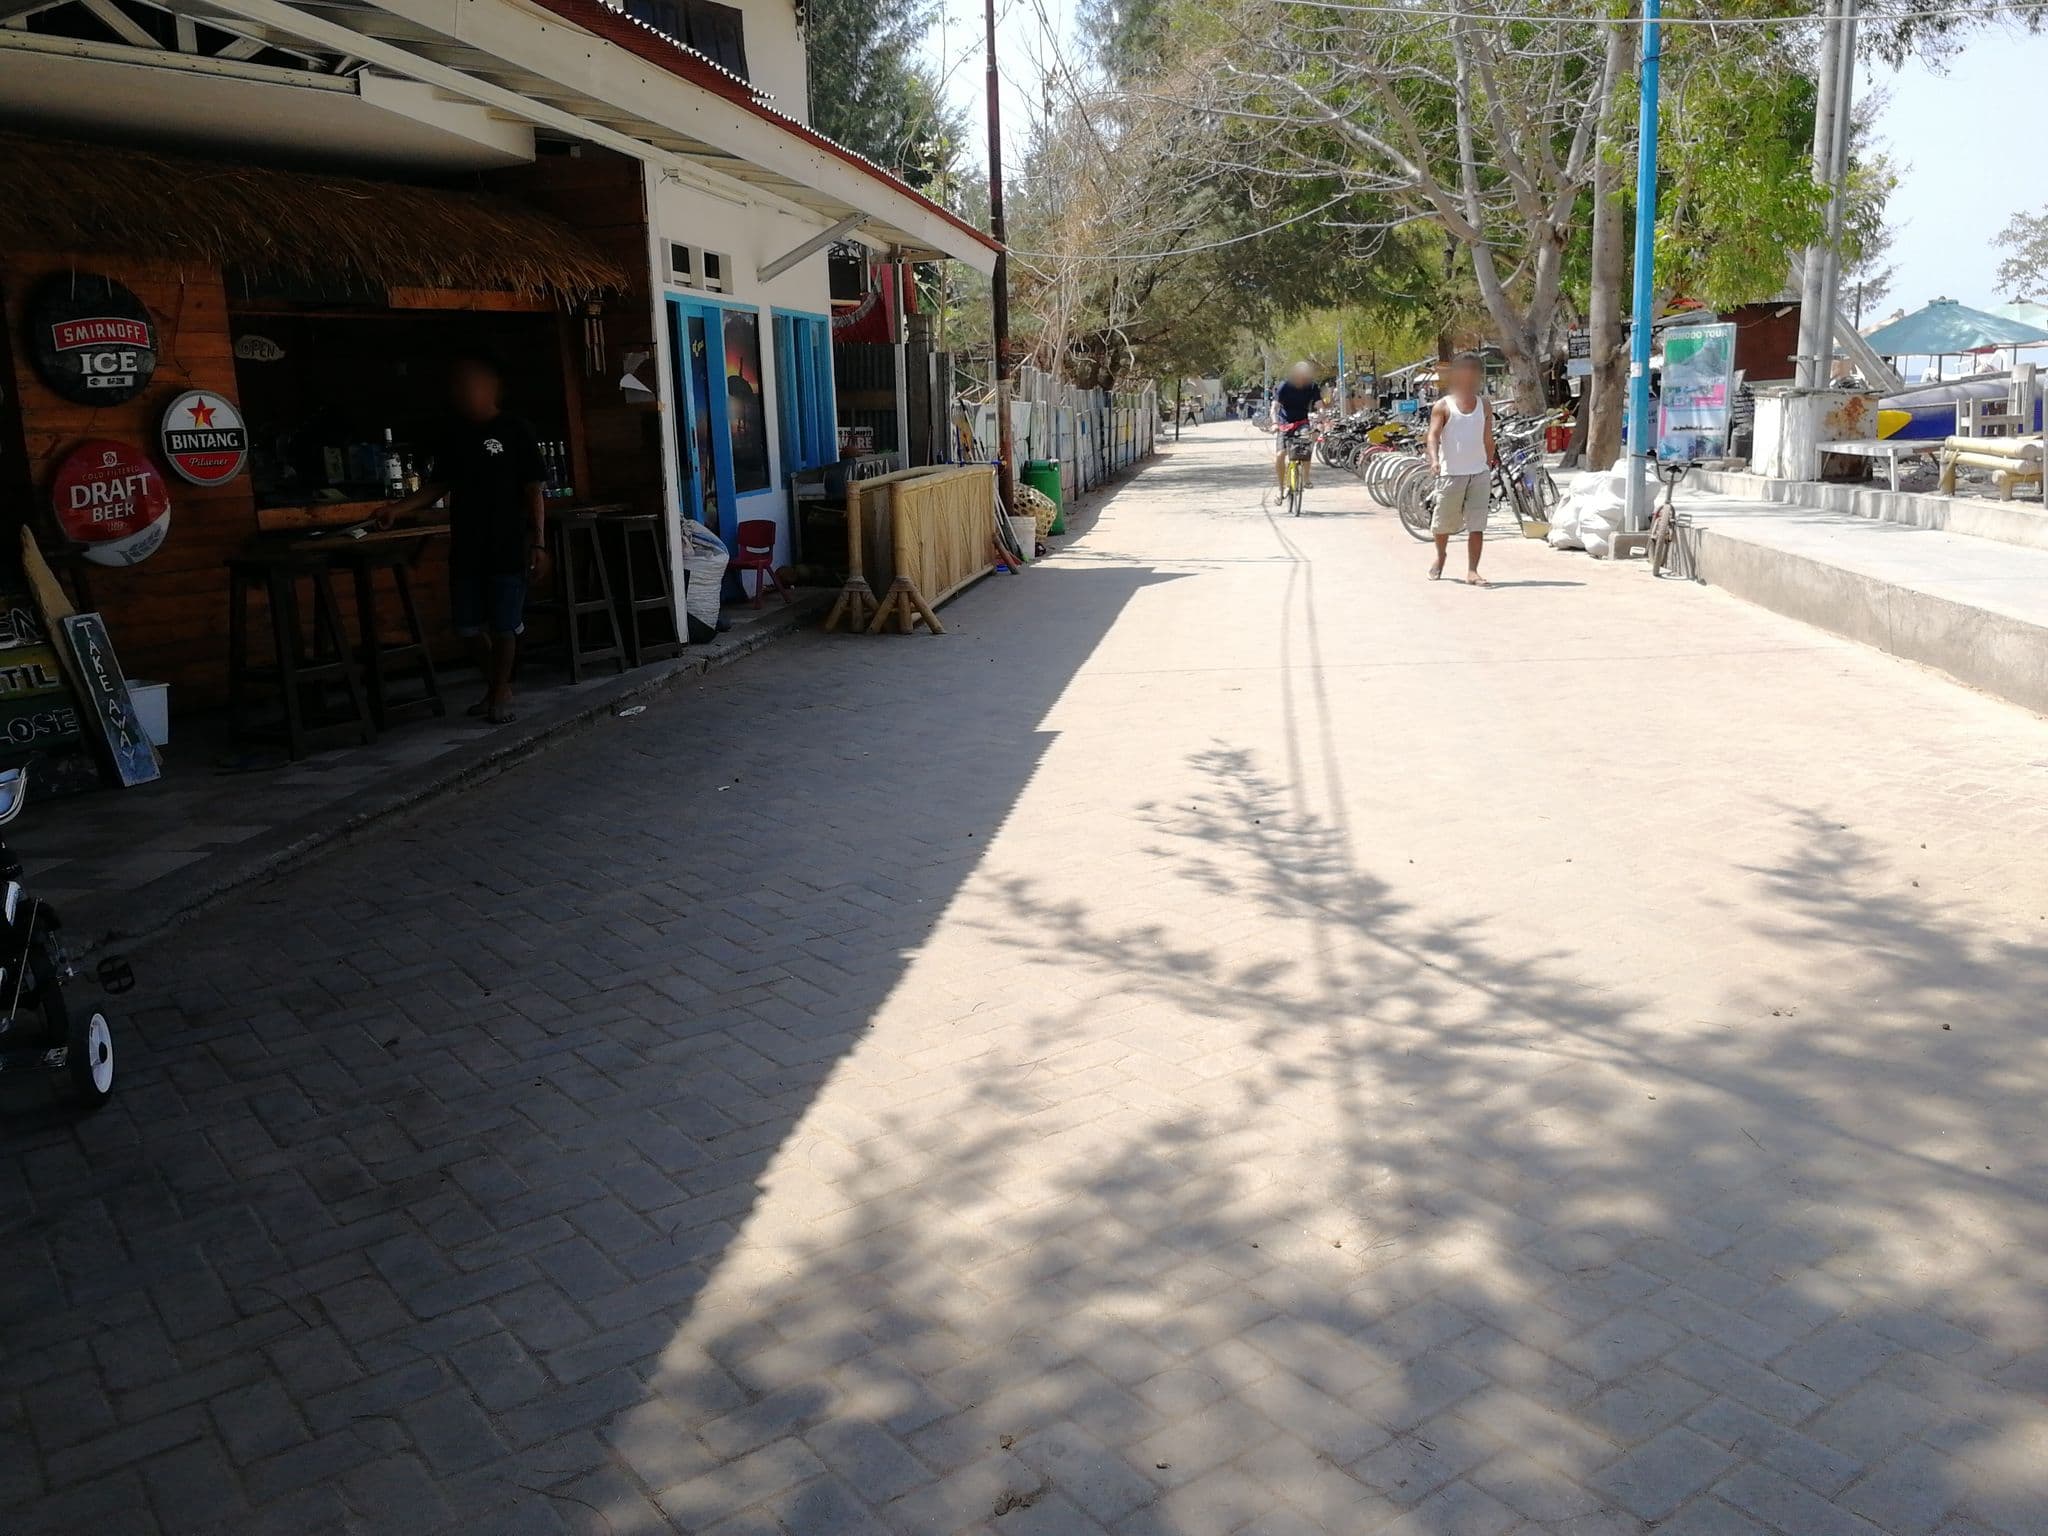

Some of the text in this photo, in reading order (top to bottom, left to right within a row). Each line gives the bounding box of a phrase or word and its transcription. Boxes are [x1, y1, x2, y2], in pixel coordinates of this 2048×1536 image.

[63, 323, 142, 343] SMIRNOFF
[80, 351, 138, 375] ICE
[171, 432, 239, 450] BINTANG
[188, 455, 230, 467] Pilsener
[70, 472, 152, 509] DRAFT
[92, 502, 136, 523] BEER
[76, 620, 135, 767] TAKE AWAY
